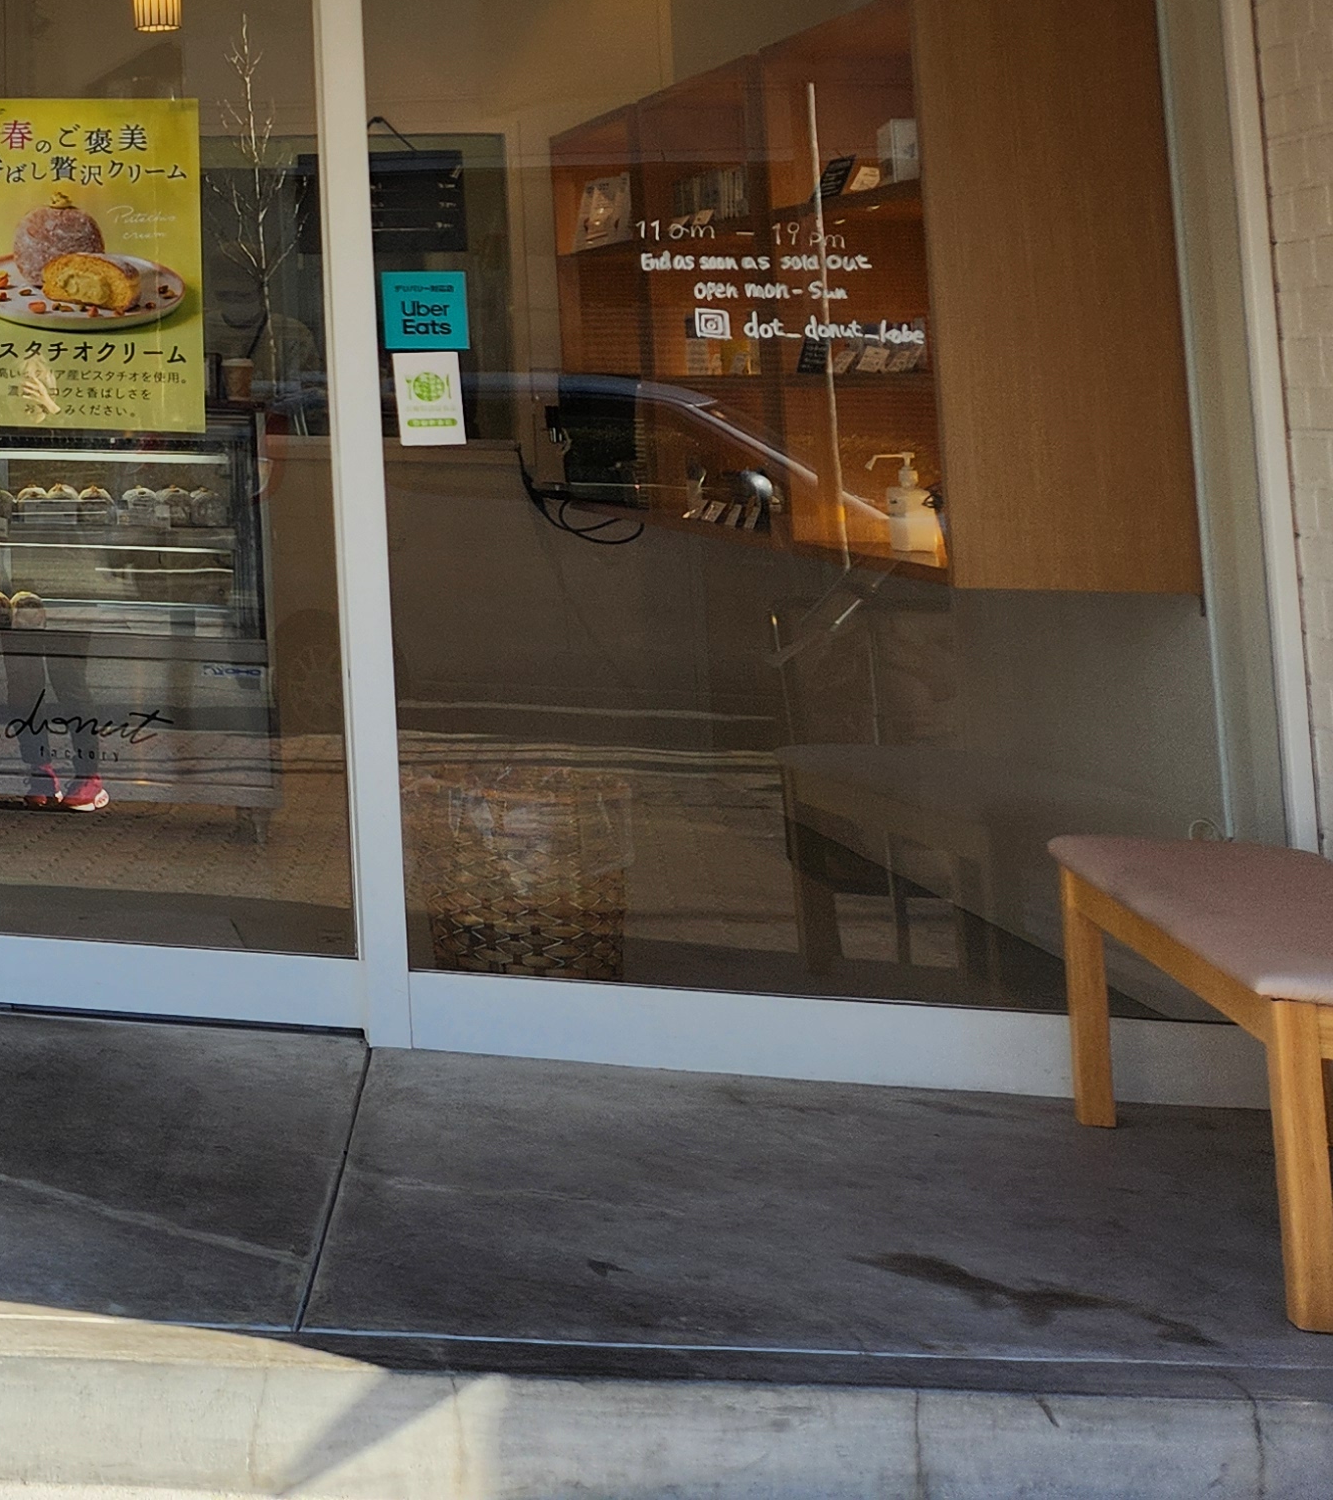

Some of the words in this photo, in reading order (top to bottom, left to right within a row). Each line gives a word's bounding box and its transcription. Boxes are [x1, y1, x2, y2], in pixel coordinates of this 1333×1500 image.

[0, 120, 148, 155] 春のご褒美
[741, 254, 771, 271] as
[400, 301, 450, 317] Uber
[402, 319, 452, 335] Eats
